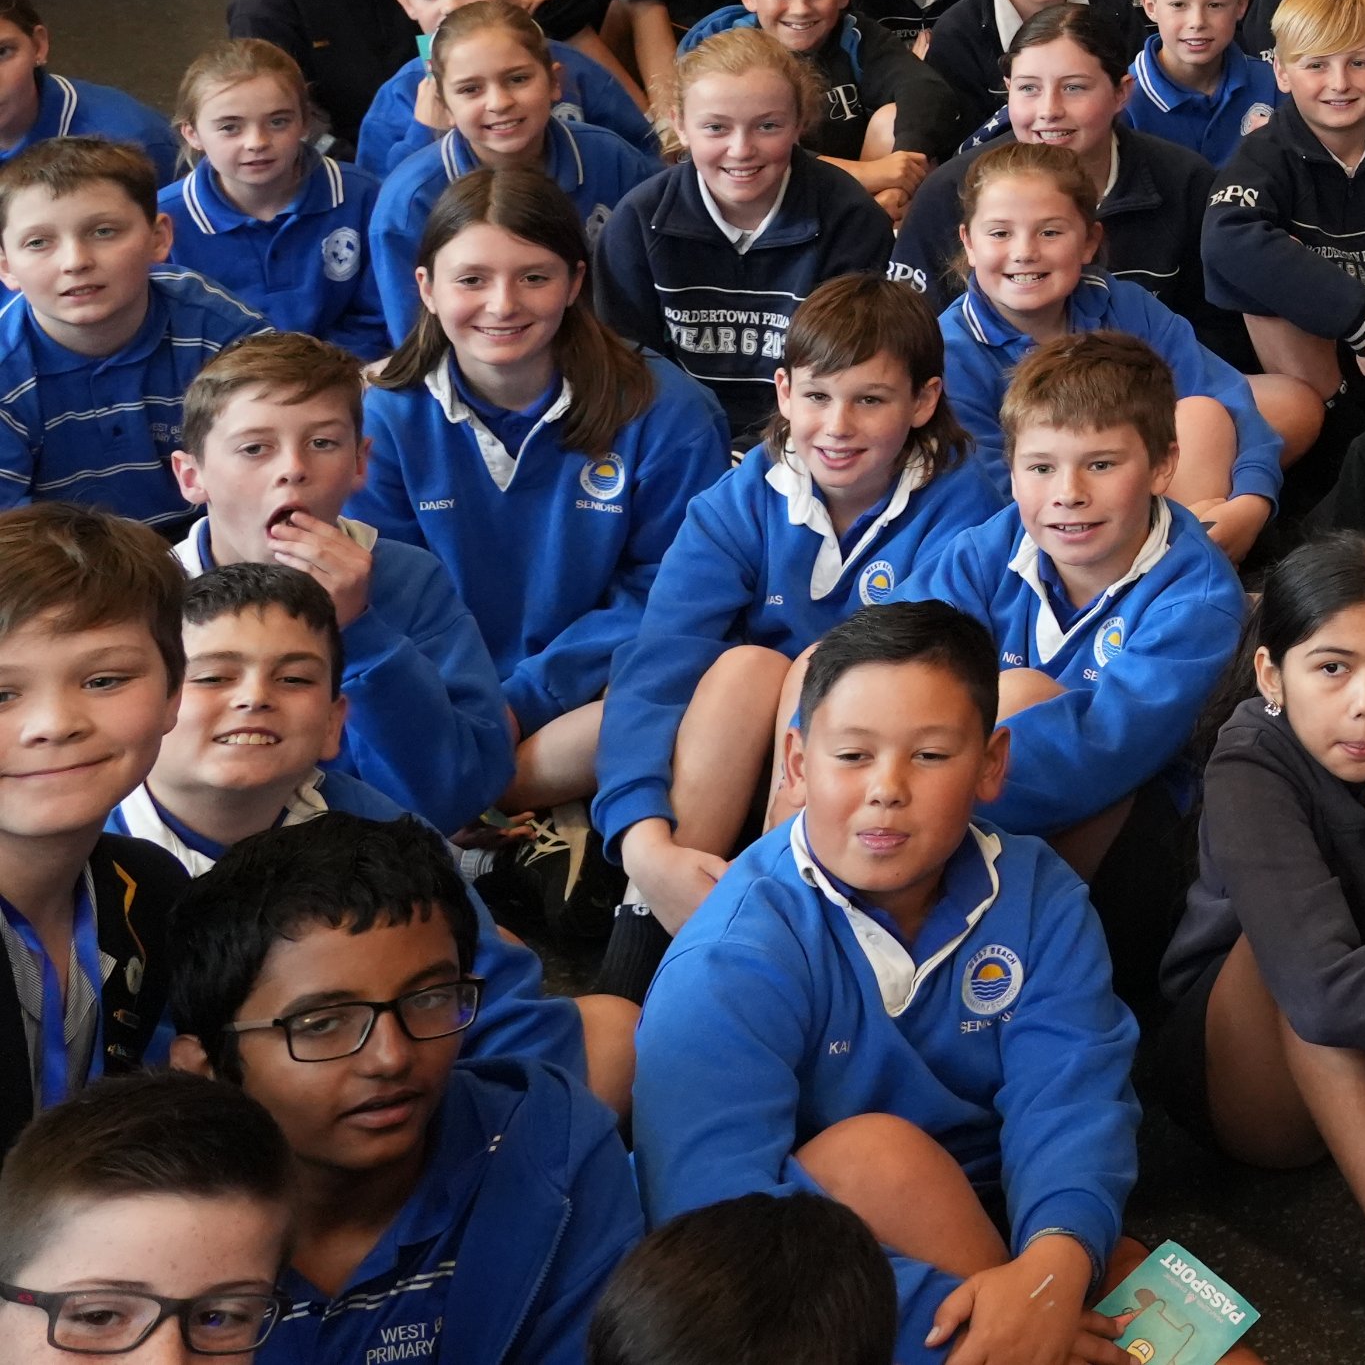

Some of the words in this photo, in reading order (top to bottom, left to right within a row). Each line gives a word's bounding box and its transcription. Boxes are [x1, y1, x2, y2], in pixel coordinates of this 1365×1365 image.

[664, 306, 760, 325] BORDERTOWN
[666, 319, 737, 354] YEAR
[741, 327, 759, 356] 6
[419, 498, 455, 511] DAISY
[575, 499, 624, 514] SENIORS
[1002, 651, 1024, 666] NIC
[990, 946, 1018, 967] BEACH
[1160, 1253, 1246, 1325] PASSPORT
[380, 1322, 428, 1345] WEST
[366, 1337, 436, 1365] PRIMARY
